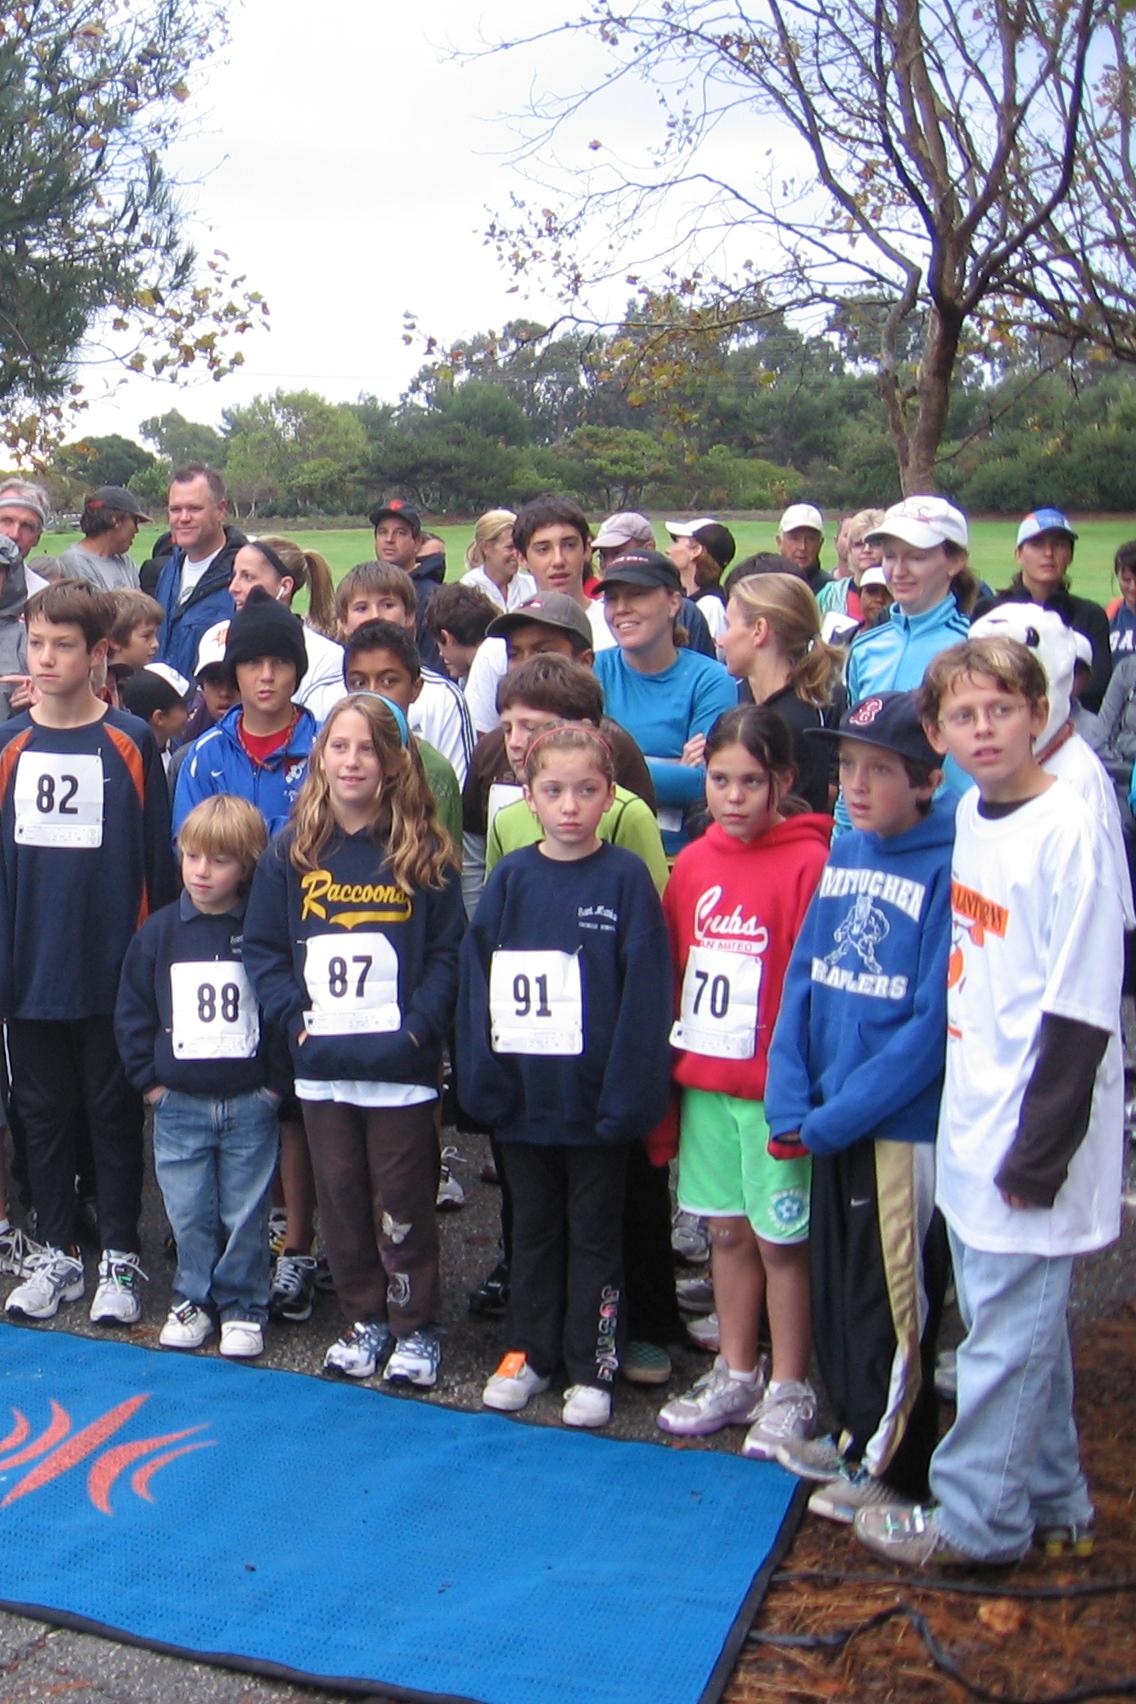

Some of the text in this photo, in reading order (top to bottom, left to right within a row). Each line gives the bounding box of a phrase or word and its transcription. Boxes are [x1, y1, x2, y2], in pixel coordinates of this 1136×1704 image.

[36, 774, 79, 814] 82
[694, 885, 767, 941] Cubs
[328, 956, 373, 998] 87
[513, 974, 552, 1018] 91
[694, 970, 731, 1019] 70
[197, 983, 240, 1024] 88
